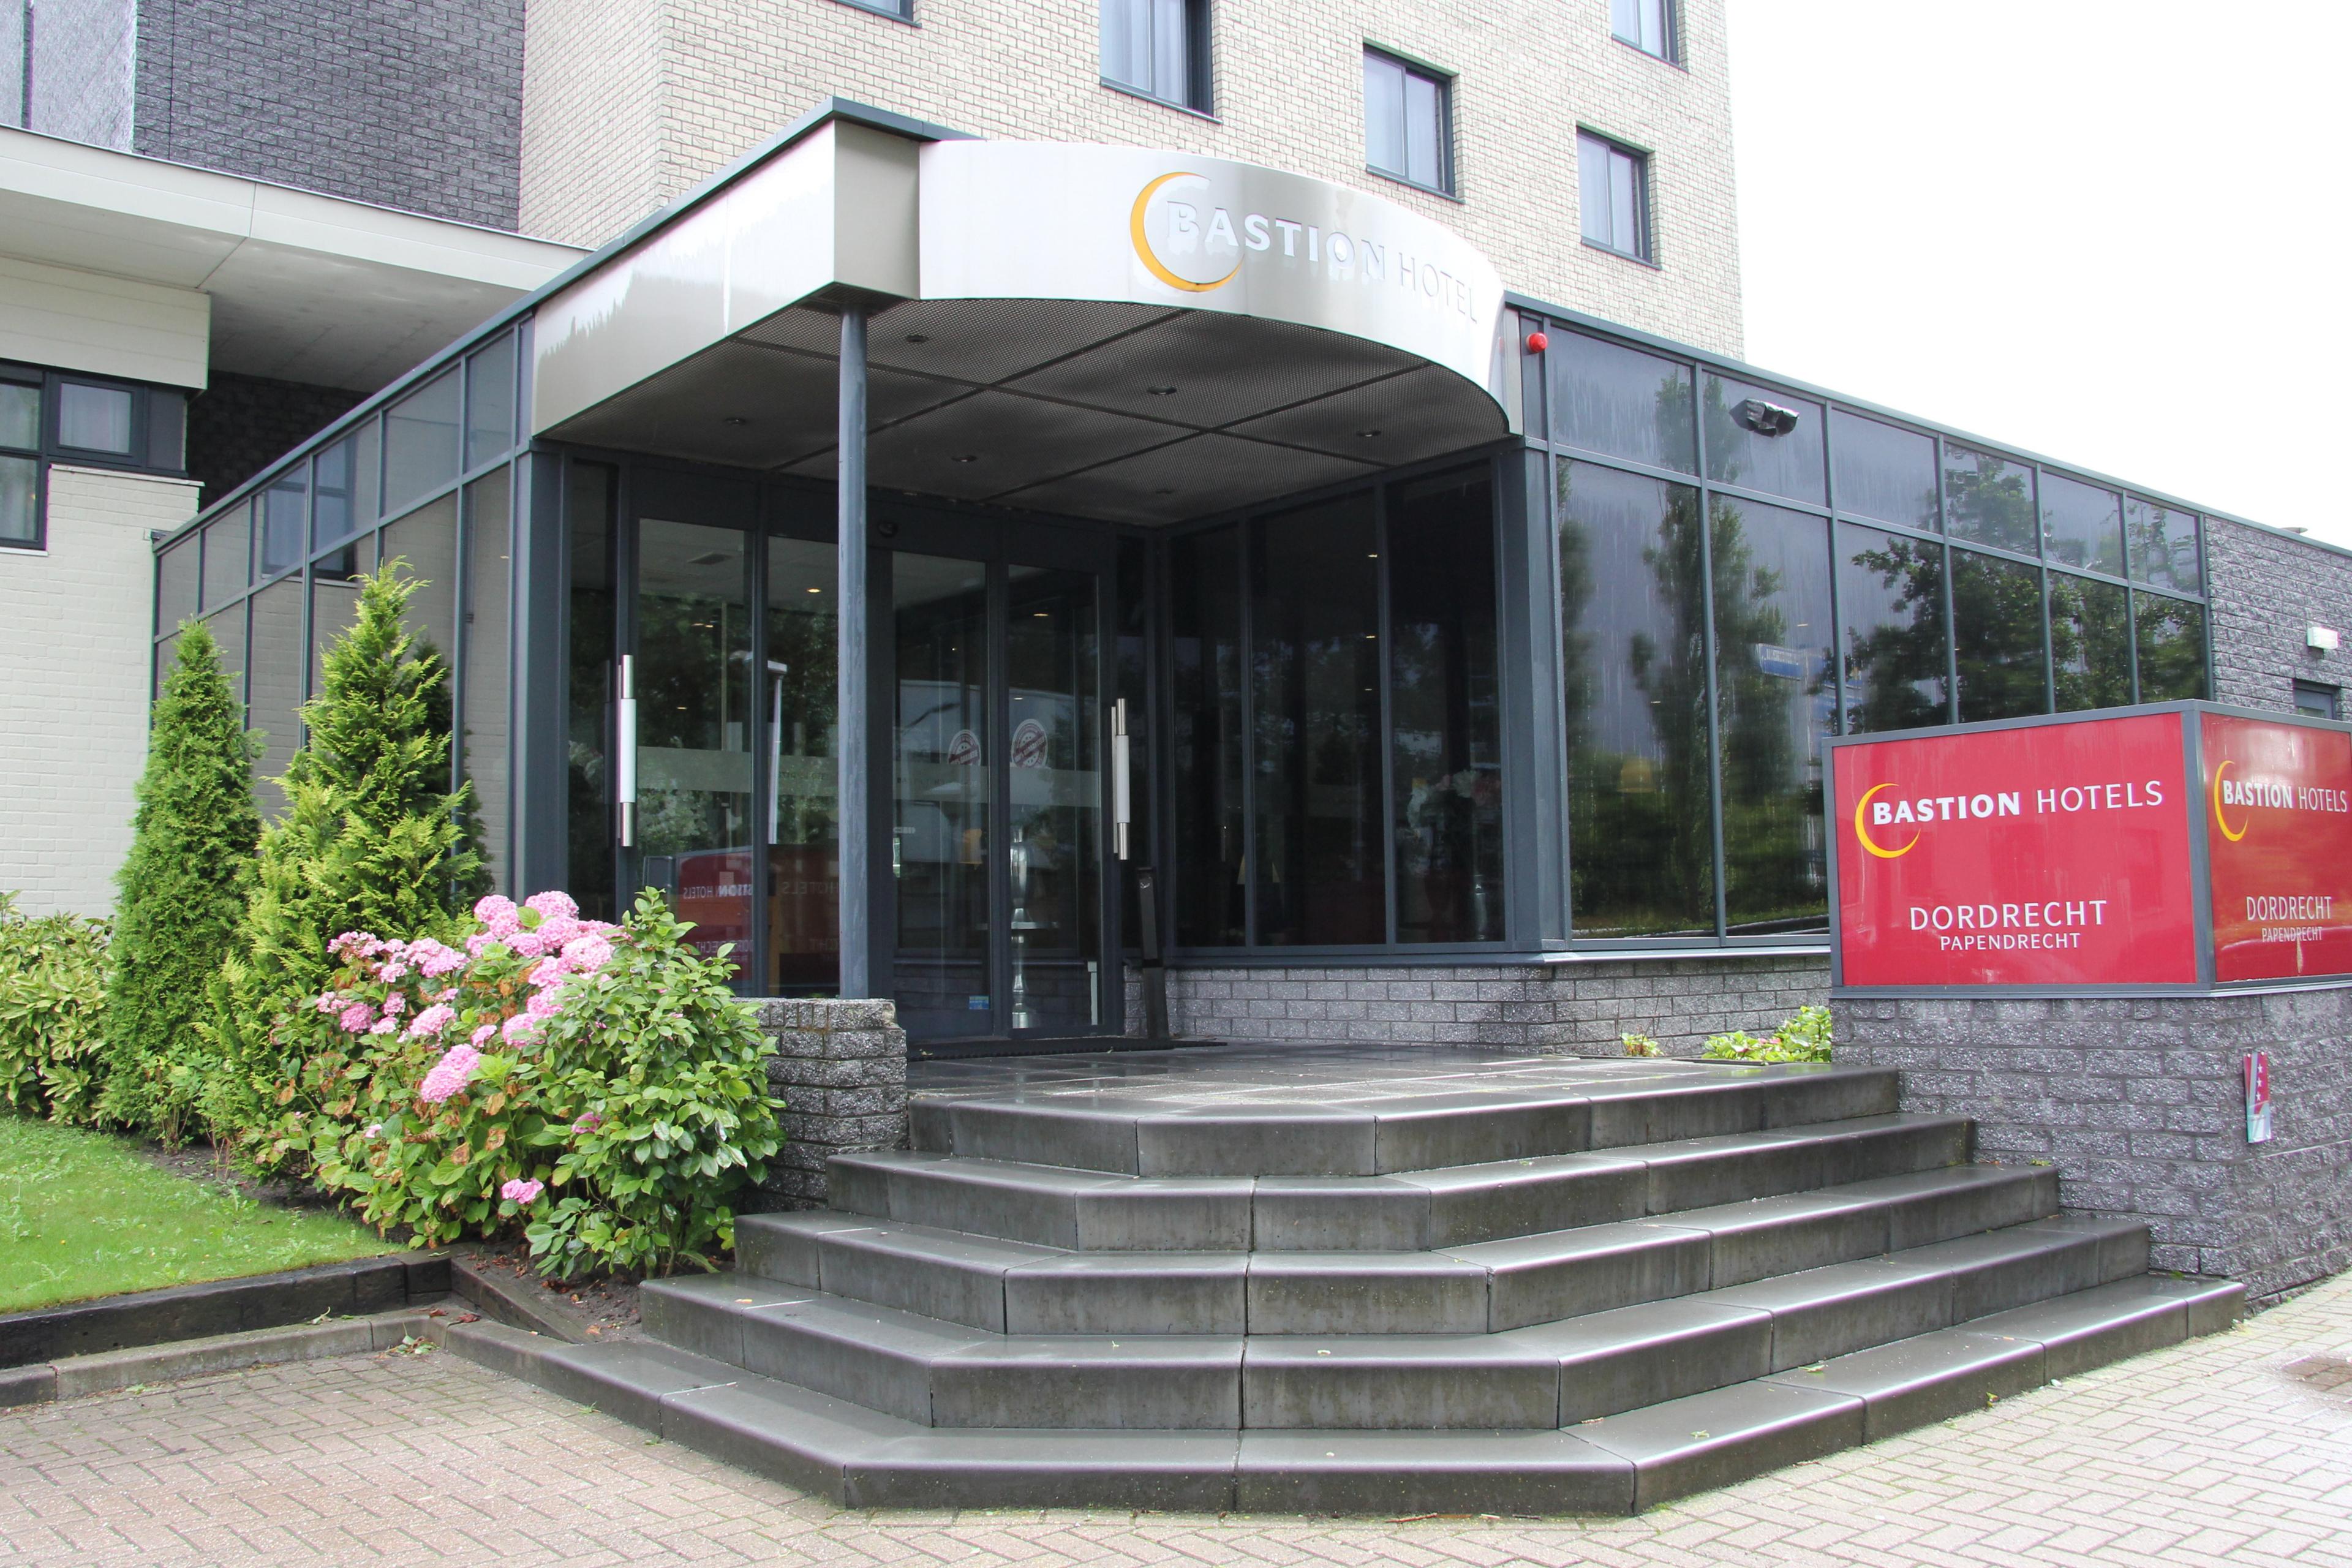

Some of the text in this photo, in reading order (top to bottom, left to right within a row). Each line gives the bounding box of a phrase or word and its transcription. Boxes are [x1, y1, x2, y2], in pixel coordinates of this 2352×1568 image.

[1167, 200, 1477, 324] BASTION HOTEL
[1873, 780, 2163, 825] BASTION HOTELS
[2223, 780, 2348, 813] BASTION HOTELS
[1910, 900, 2107, 930] DORDRECHT
[2247, 895, 2332, 919] DORDRECHT
[1940, 933, 2081, 951] PAPENDRECHT
[2261, 927, 2323, 942] PAPENDRECHT
